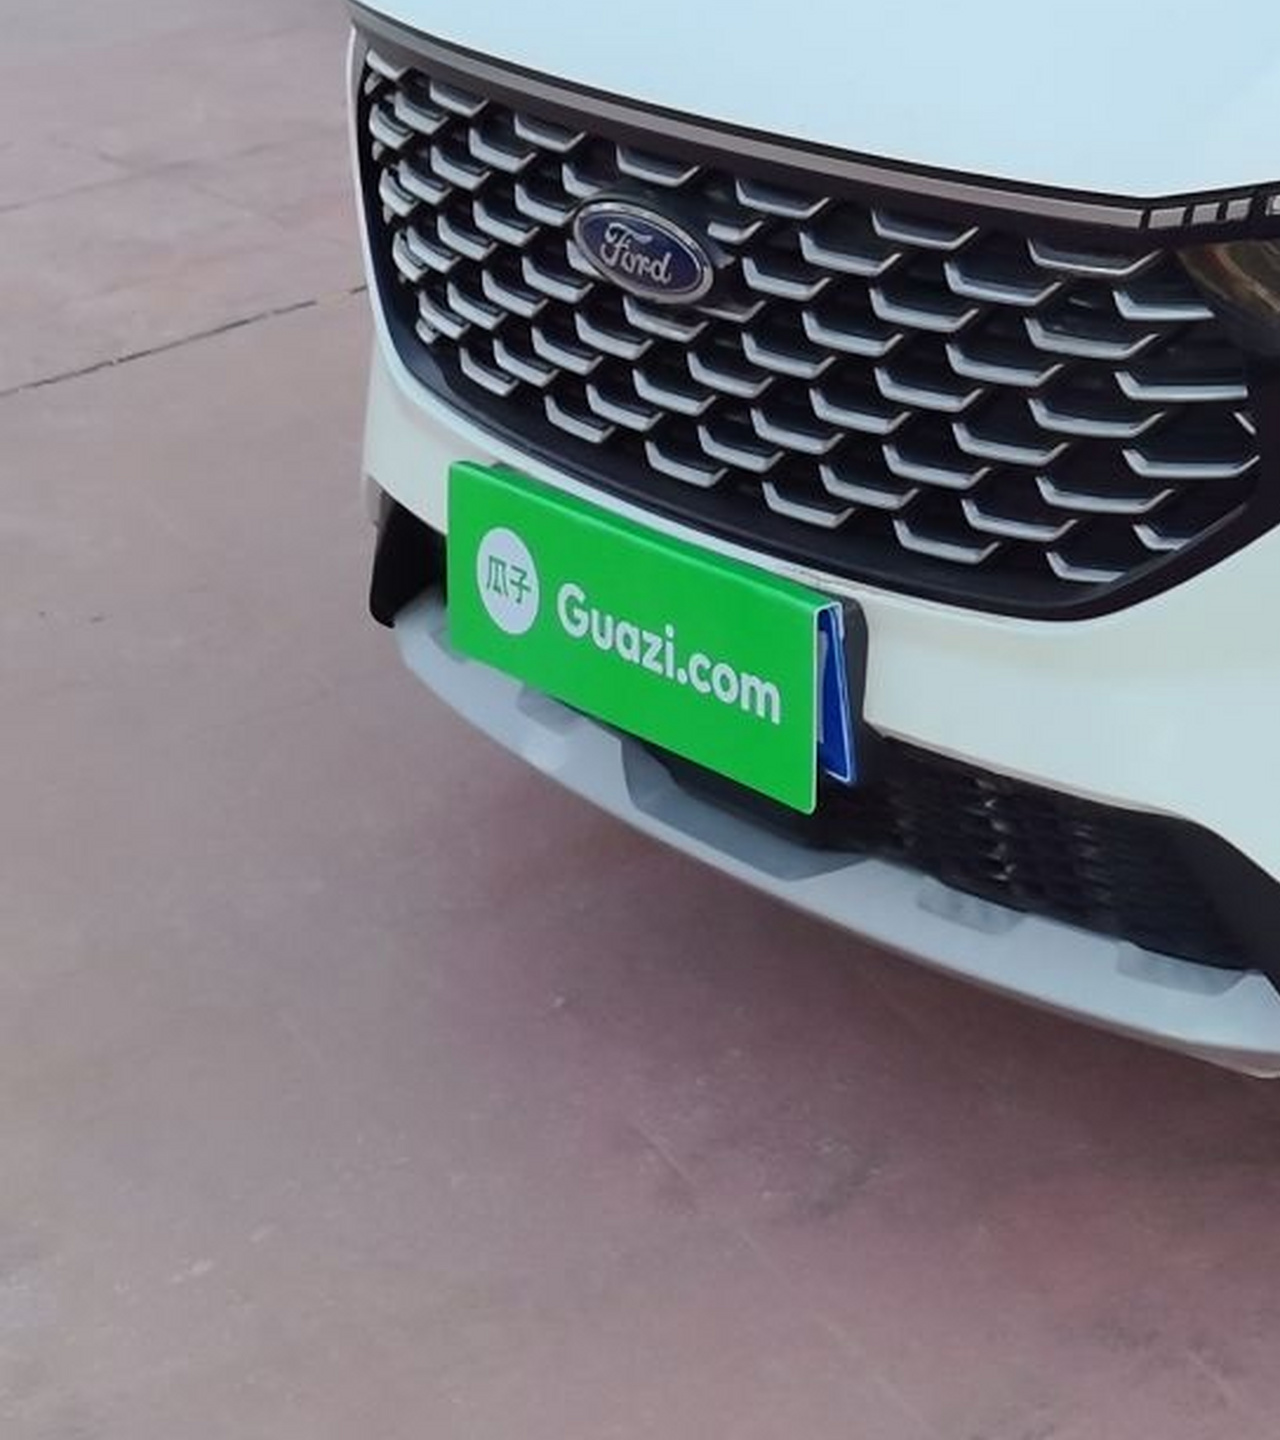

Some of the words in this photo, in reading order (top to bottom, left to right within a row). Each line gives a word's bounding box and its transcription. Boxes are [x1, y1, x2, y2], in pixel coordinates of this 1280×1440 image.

[601, 222, 672, 284] Ford
[486, 555, 532, 605] 瓜子
[557, 582, 781, 725] Guazi.com
